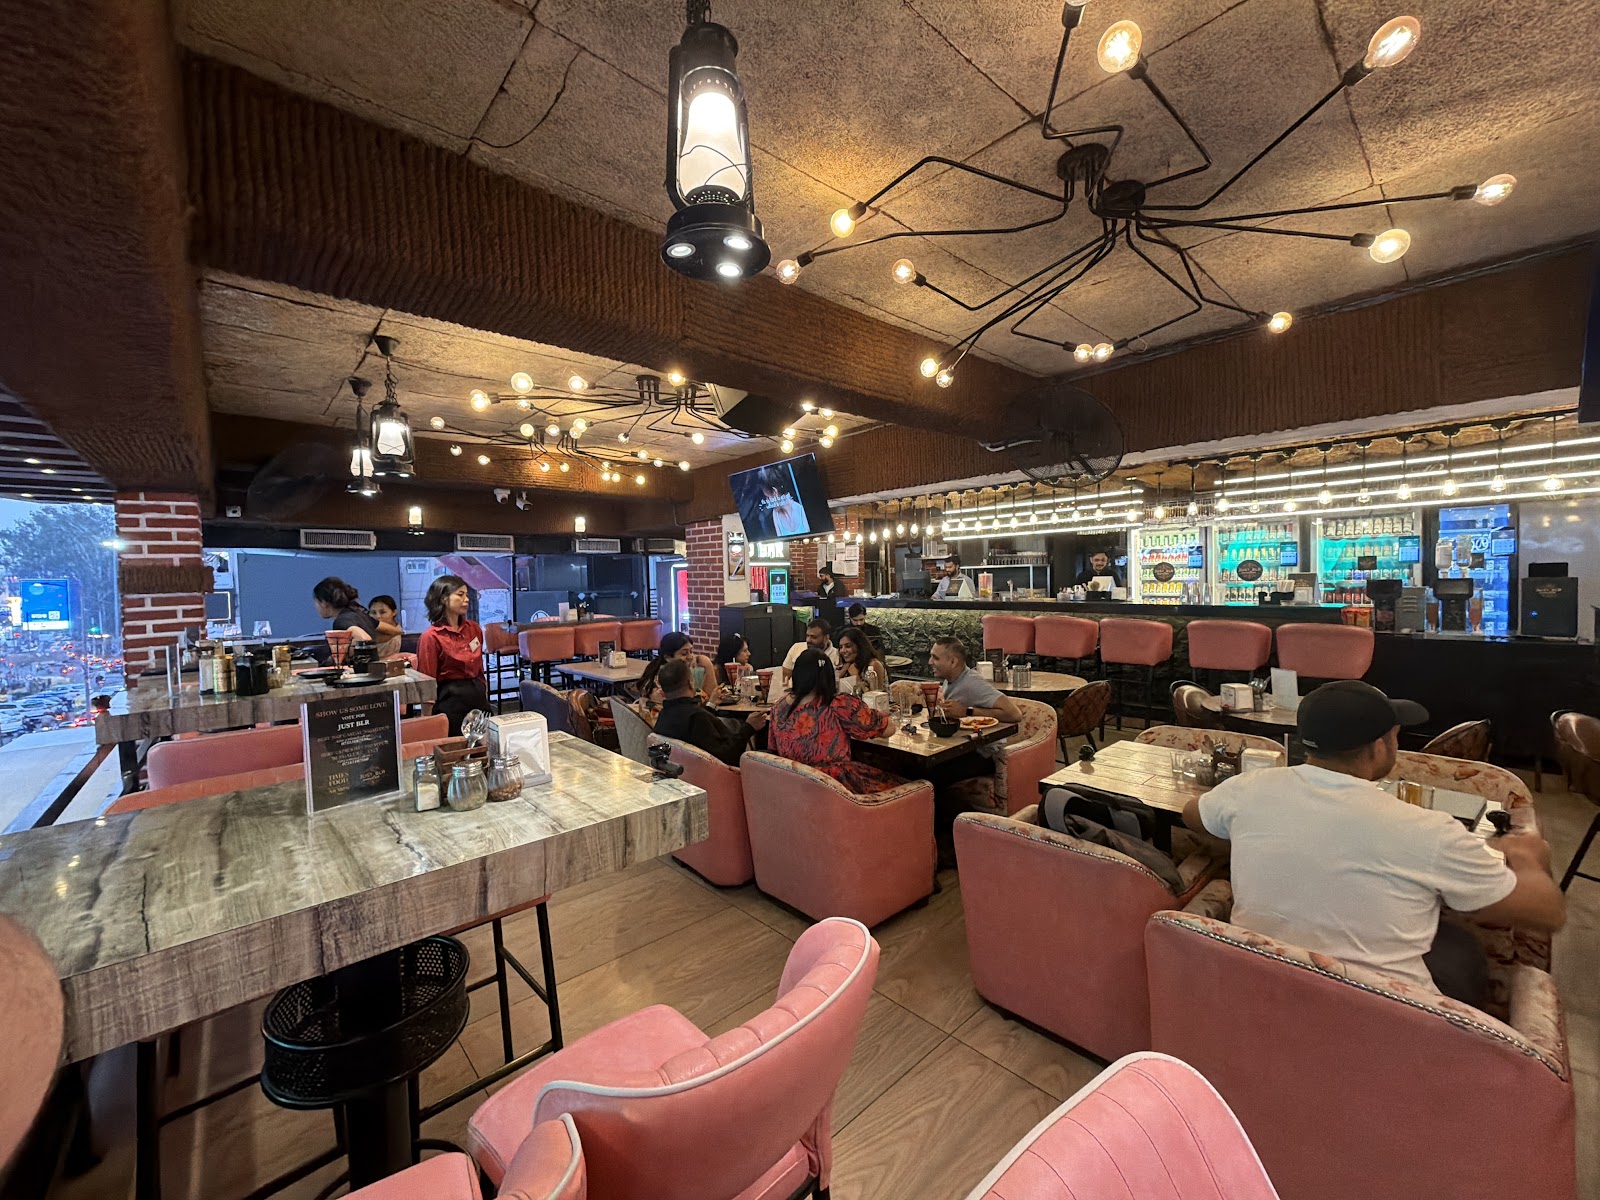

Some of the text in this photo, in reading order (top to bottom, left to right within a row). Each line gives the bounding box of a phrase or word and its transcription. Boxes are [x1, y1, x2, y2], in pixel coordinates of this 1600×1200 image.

[316, 702, 387, 718] SHOW US SOME LOVE
[337, 719, 370, 731] JUST BLR
